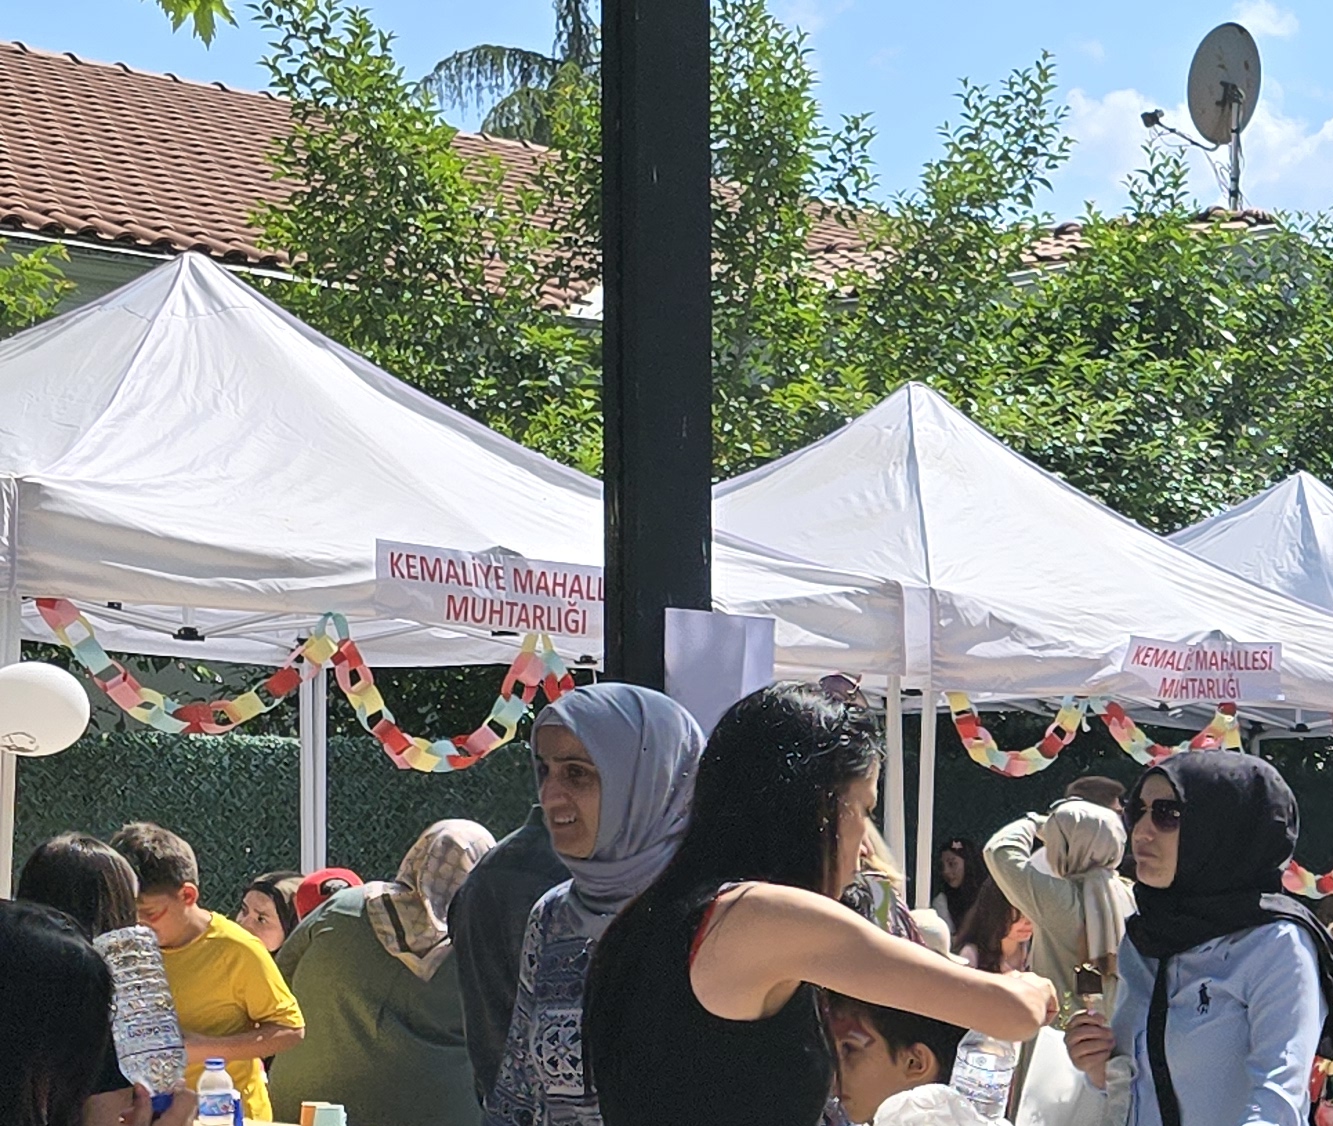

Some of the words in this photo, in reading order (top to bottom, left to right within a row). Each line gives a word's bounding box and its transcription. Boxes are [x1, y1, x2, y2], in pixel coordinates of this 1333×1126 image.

[390, 551, 506, 591] KEMALİYE
[513, 567, 604, 601] MAHALL
[446, 594, 587, 635] MUHTARLIĞI
[1195, 646, 1273, 671] MAHALLESİ
